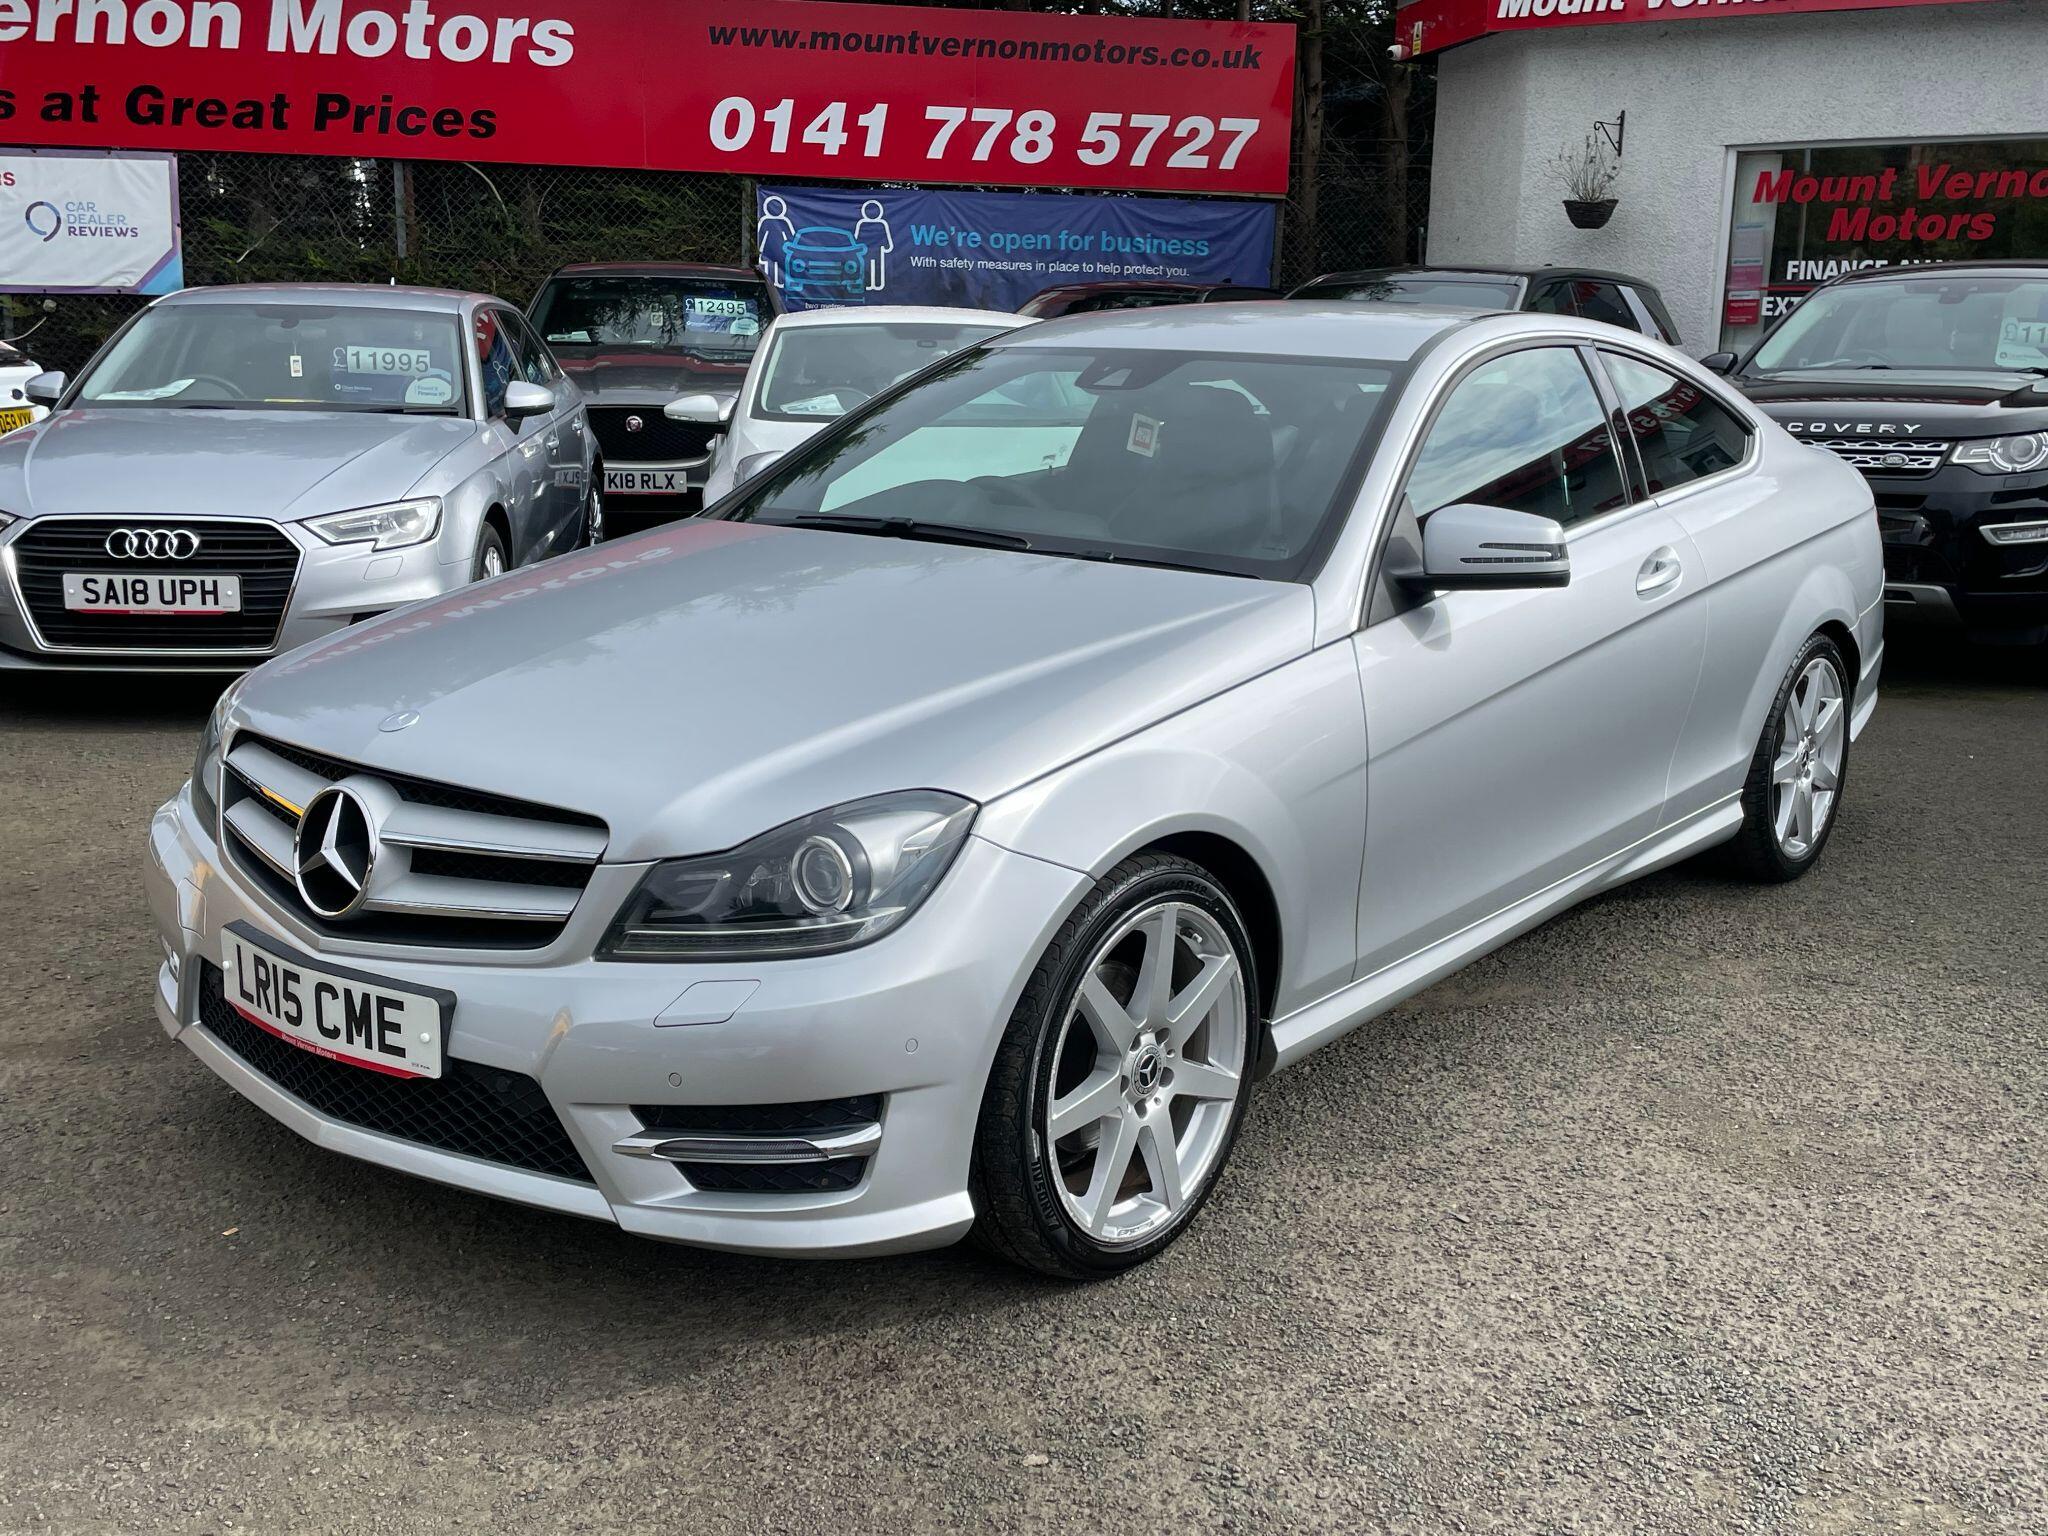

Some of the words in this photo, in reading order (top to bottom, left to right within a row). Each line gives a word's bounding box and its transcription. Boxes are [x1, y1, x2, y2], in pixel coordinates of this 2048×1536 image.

[267, 0, 575, 66] Motors
[708, 25, 1263, 69] www.mountvernonmotors.co.uk
[40, 84, 101, 123] at
[125, 84, 292, 131] Great
[313, 92, 498, 139] Prices
[709, 96, 889, 157] 0141
[924, 105, 1056, 165] 778
[1077, 111, 1260, 170] 5727
[1752, 167, 1898, 204] Mount
[65, 201, 97, 213] CAR
[67, 214, 127, 226] DEALER
[67, 226, 139, 238] REVIEWS
[1826, 207, 1997, 242] Motors
[989, 231, 1051, 254] open
[1059, 229, 1094, 251] for
[1100, 231, 1210, 256] business
[910, 256, 937, 268] With
[940, 257, 975, 272] safety
[978, 260, 1033, 271] measures
[1035, 261, 1046, 271] in
[1048, 262, 1080, 275] place
[1082, 262, 1094, 272] to
[1096, 263, 1121, 275] help
[1123, 264, 1164, 276] protect
[1166, 267, 1190, 278] you.
[640, 473, 675, 490] RLX
[82, 577, 150, 606] SA18
[158, 578, 219, 606] UPH
[236, 943, 303, 1028] LR15
[314, 981, 407, 1059] CME
